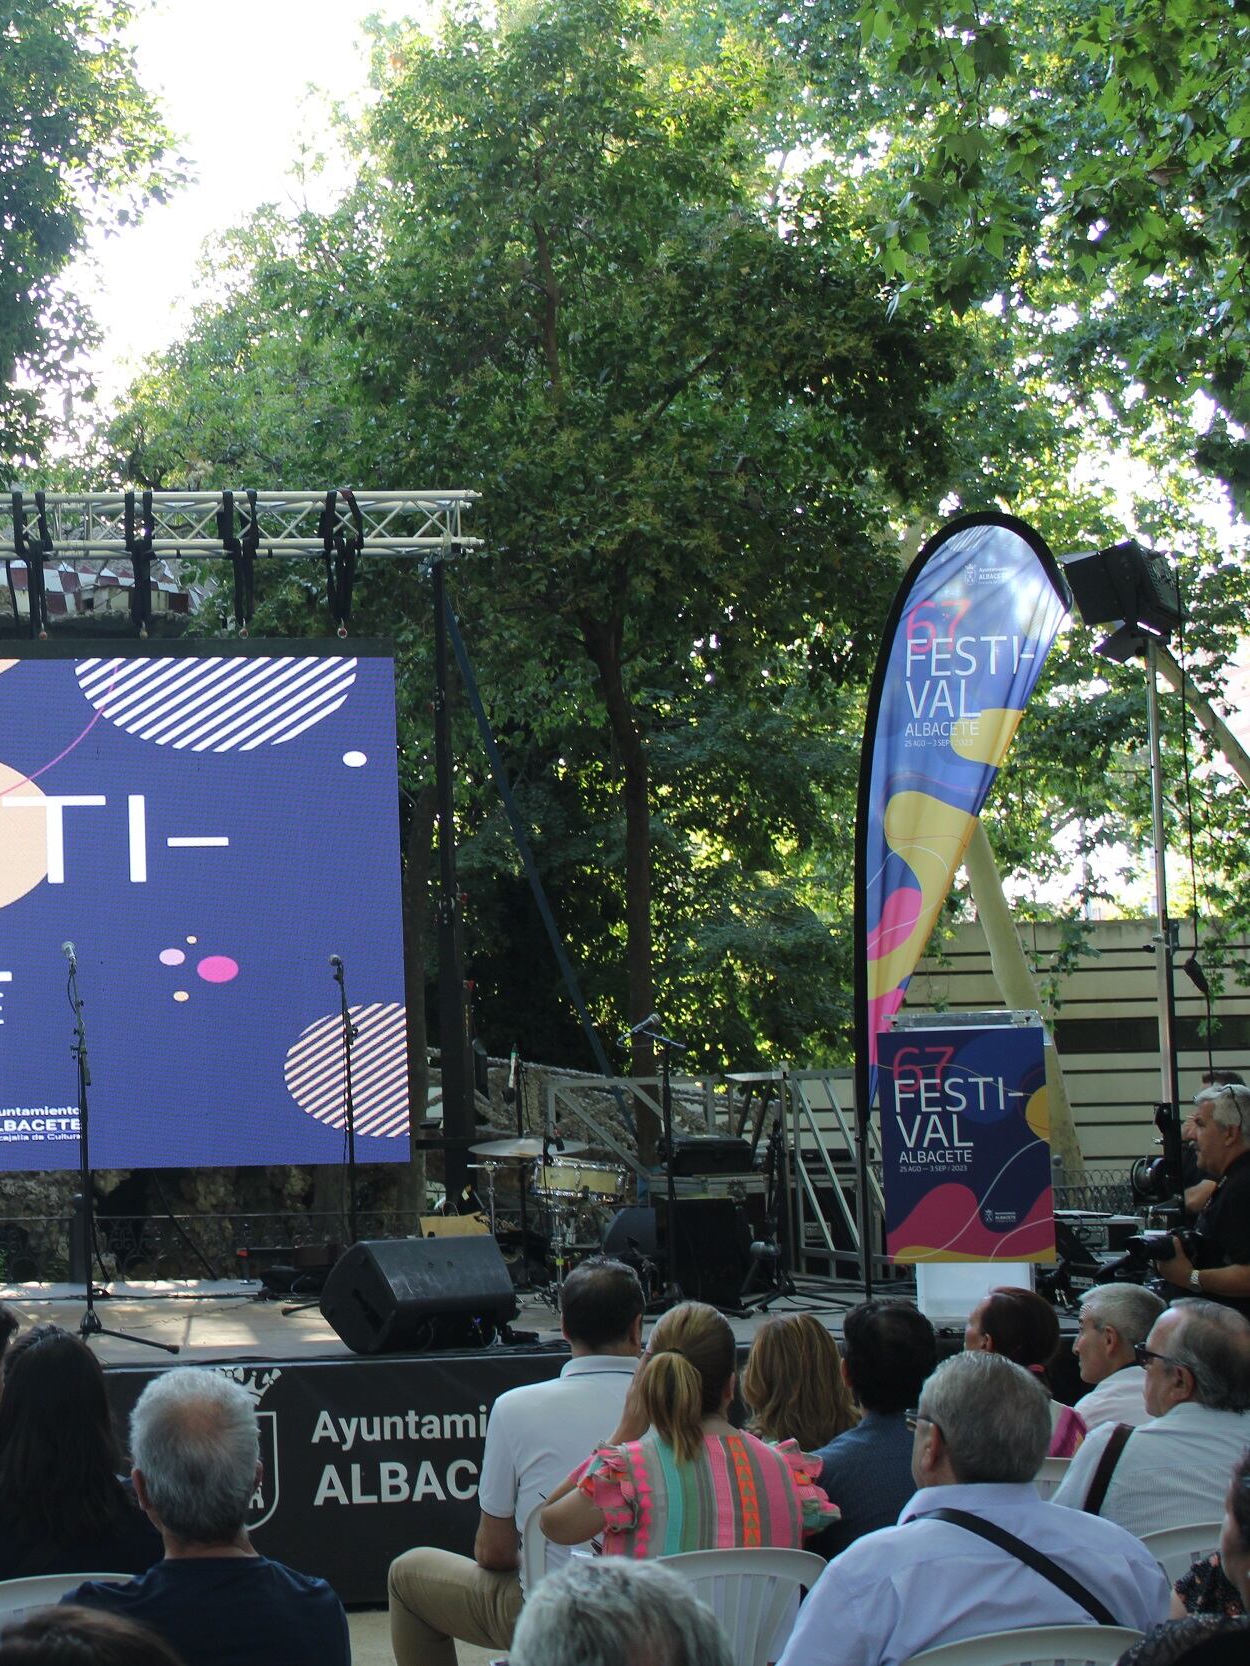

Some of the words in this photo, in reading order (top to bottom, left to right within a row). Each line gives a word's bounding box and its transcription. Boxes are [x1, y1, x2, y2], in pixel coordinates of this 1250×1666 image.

[906, 599, 971, 653] 67
[906, 636, 1035, 677] FESTI-
[906, 679, 981, 719] VAL
[905, 722, 980, 737] ALBACETE
[893, 1047, 954, 1091] 67
[894, 1077, 1024, 1113] FESTI-
[896, 1114, 974, 1148] VAL
[899, 1150, 972, 1163] ALBACETE
[311, 1405, 488, 1451] Ayuntami
[313, 1459, 479, 1506] ALBAC
